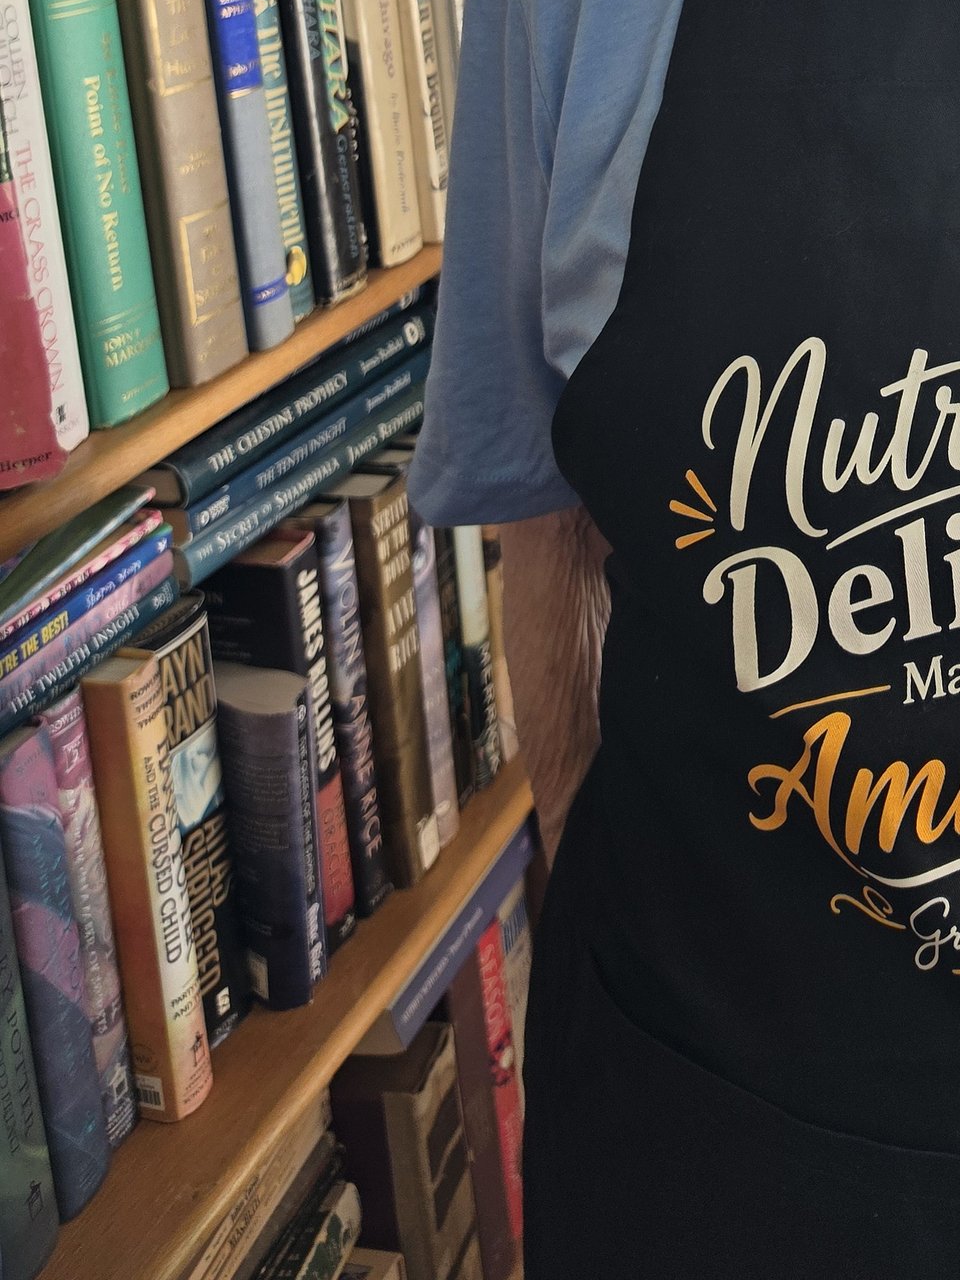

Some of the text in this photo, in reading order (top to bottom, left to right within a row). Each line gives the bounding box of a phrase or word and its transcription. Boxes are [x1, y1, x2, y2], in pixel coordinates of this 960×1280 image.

[4, 4, 28, 100] COLLEEN
[84, 74, 105, 138] Point
[257, 25, 307, 250] The Instrument
[94, 142, 112, 168] of
[96, 170, 114, 208] No
[16, 140, 37, 194] THE
[36, 286, 65, 394] CROWN
[101, 210, 124, 293] Return
[208, 443, 239, 473] THE
[234, 405, 296, 457] CELESTINE
[293, 370, 349, 418] PROPHECY
[255, 467, 277, 490] THE
[274, 444, 309, 479] TENTH
[306, 416, 348, 454] INSIGHT
[214, 510, 260, 553] SECRET
[273, 456, 341, 510] SHAMBHALA
[345, 434, 379, 467] JAMES
[9, 688, 37, 715] THE
[37, 642, 92, 691] TWELFTH
[91, 602, 141, 651] INSIGHT
[20, 638, 40, 661] THE
[41, 610, 70, 645] BEST!
[160, 634, 207, 705] AYN
[296, 568, 338, 773] JAMES ROLLINS
[162, 672, 216, 747] RAND
[327, 537, 383, 860] VIOLIN ANNE RICE
[144, 755, 183, 964] AND THE CURSED CHILD
[202, 813, 233, 908] ATLAS
[321, 806, 344, 898] ORACLE
[183, 825, 222, 998] SHRUGGED
